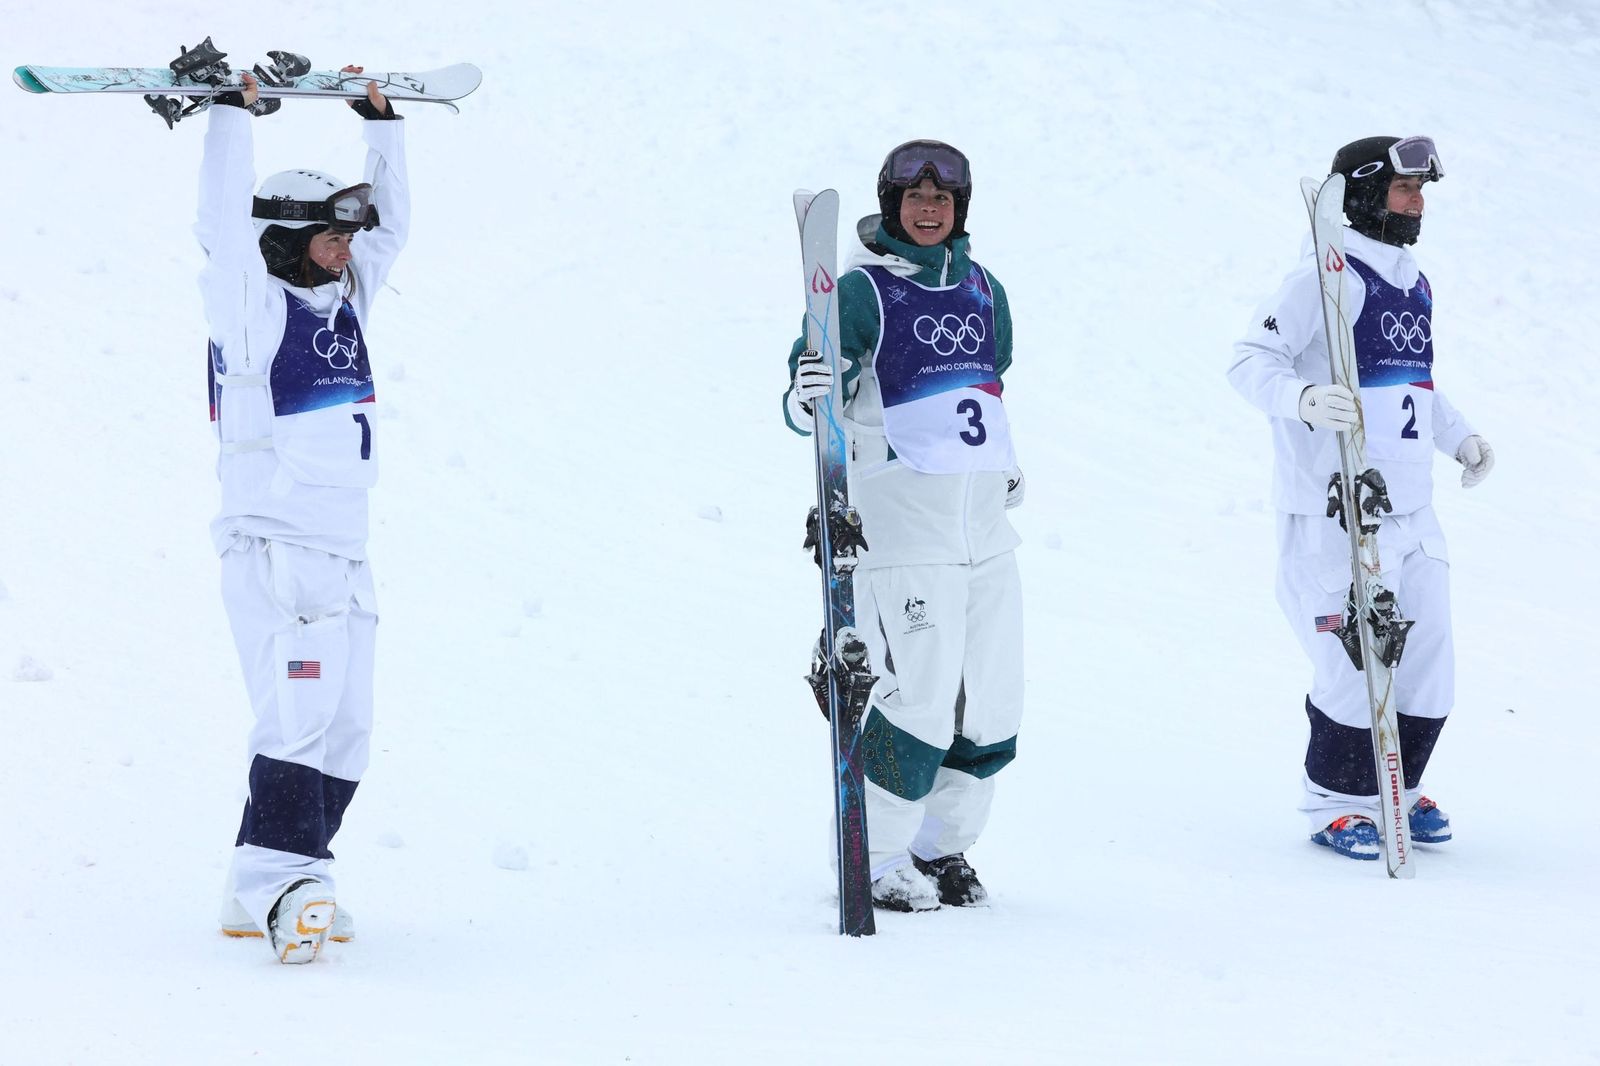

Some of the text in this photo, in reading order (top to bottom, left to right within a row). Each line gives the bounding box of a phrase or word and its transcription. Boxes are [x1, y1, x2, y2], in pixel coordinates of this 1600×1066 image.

[917, 363, 953, 375] MILANO
[953, 362, 983, 371] CORTINA
[1401, 359, 1428, 369] CORTINA
[352, 413, 371, 460] 1
[956, 398, 987, 447] 3
[1401, 394, 1418, 439] 2
